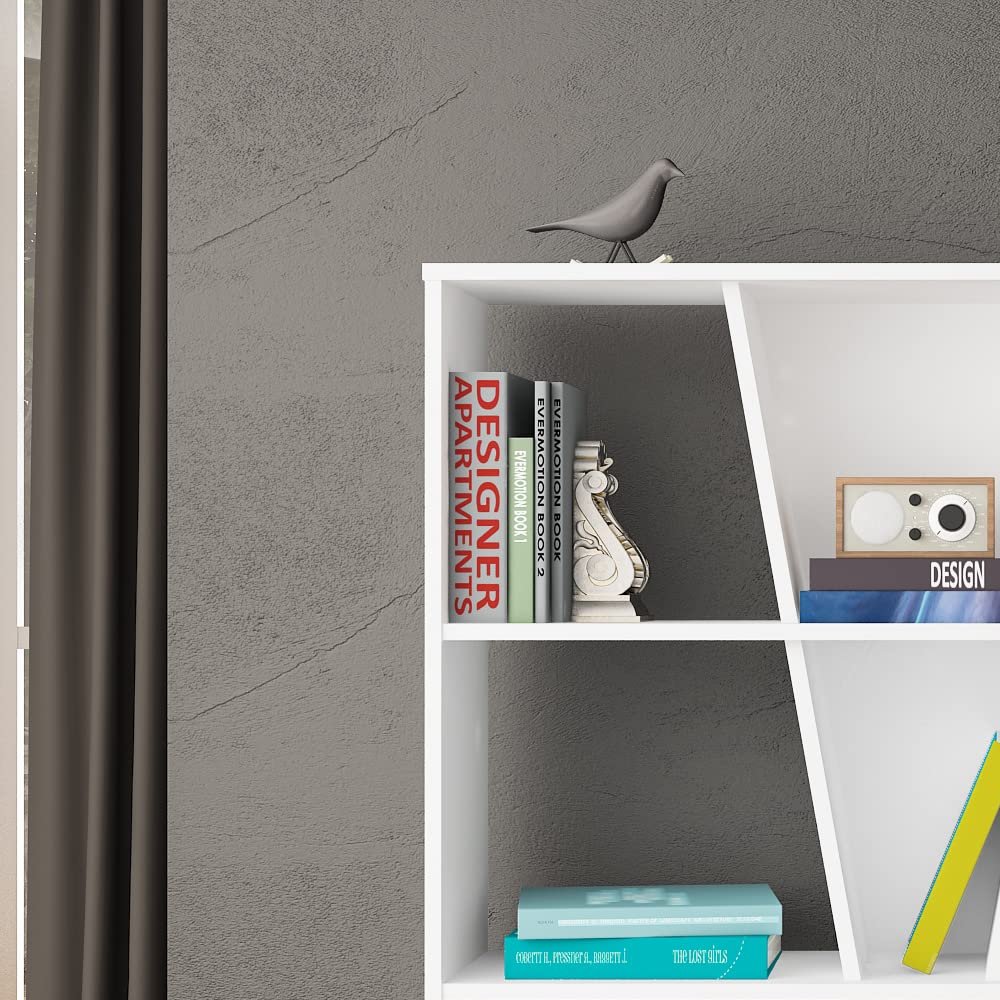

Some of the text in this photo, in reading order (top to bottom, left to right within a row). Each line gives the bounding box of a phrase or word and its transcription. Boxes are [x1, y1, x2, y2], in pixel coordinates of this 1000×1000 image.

[454, 376, 473, 615] APARTMENTS
[476, 379, 500, 611] DESIGNER
[513, 450, 528, 508] EVERMOTION
[513, 510, 528, 537] BOOK
[537, 398, 545, 577] EVERMOTION BOOK 2
[553, 398, 562, 562] EVERMOTION BOOK
[930, 560, 985, 589] DESIGN
[688, 949, 707, 964] LOST
